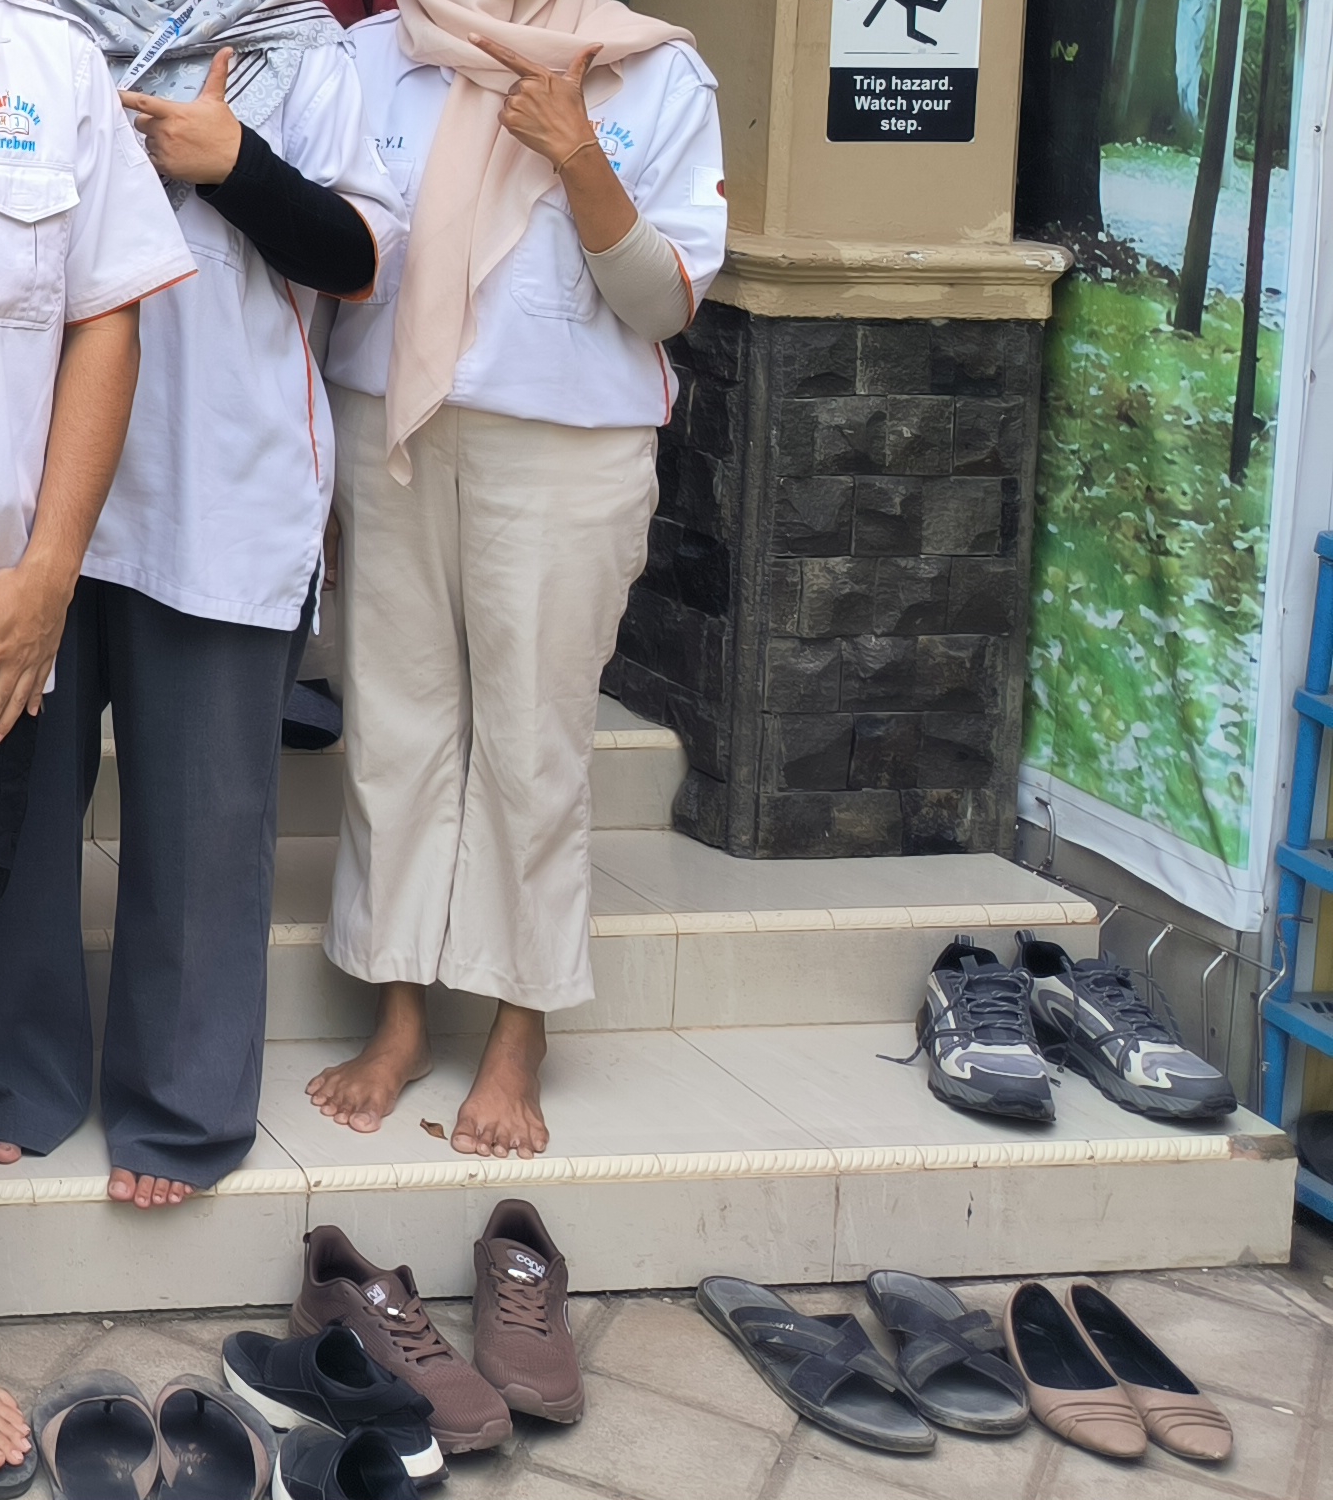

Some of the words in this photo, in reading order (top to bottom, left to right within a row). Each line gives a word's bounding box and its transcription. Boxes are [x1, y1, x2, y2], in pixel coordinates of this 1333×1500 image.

[853, 75, 887, 94] Trip
[891, 75, 954, 91] hazard.
[854, 95, 908, 111] Watch
[911, 97, 952, 115] your
[880, 116, 923, 134] step.
